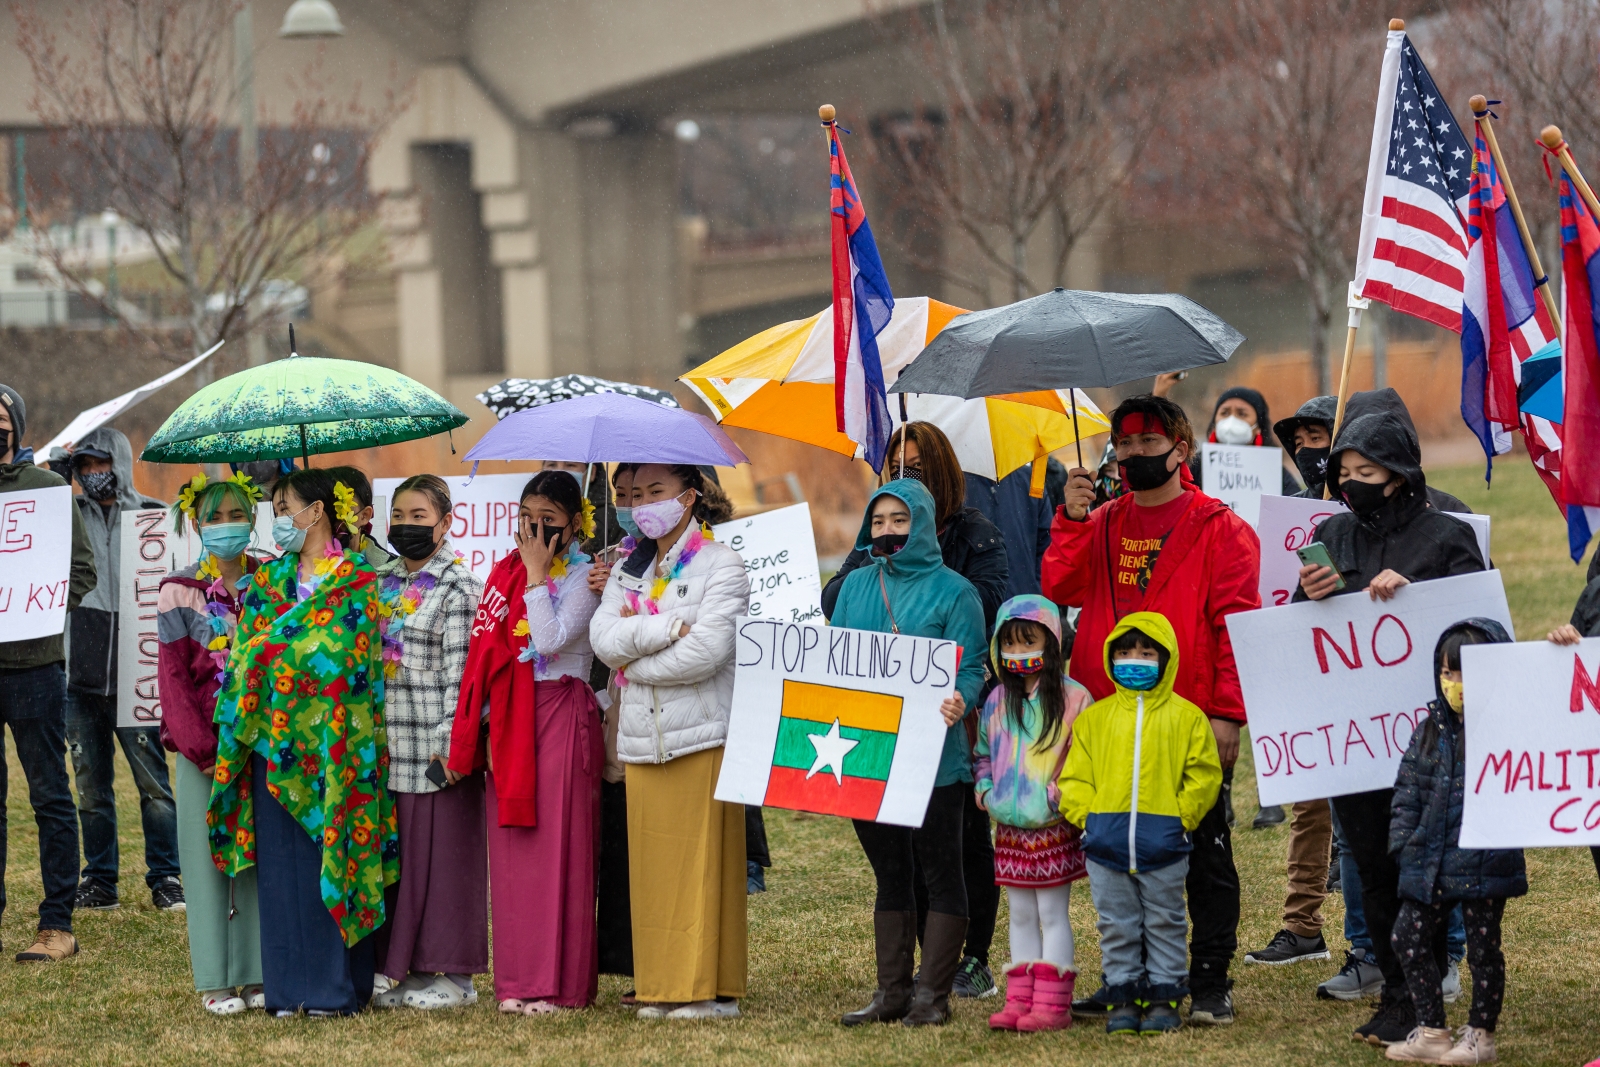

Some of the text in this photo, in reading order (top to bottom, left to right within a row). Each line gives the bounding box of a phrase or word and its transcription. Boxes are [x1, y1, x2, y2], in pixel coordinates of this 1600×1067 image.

[1209, 450, 1244, 468] FREE
[1218, 469, 1262, 491] BURMA
[25, 579, 69, 613] KYI
[738, 620, 953, 688] STOP KILLING US
[1310, 613, 1413, 674] NO
[1474, 748, 1600, 794] MALIT
